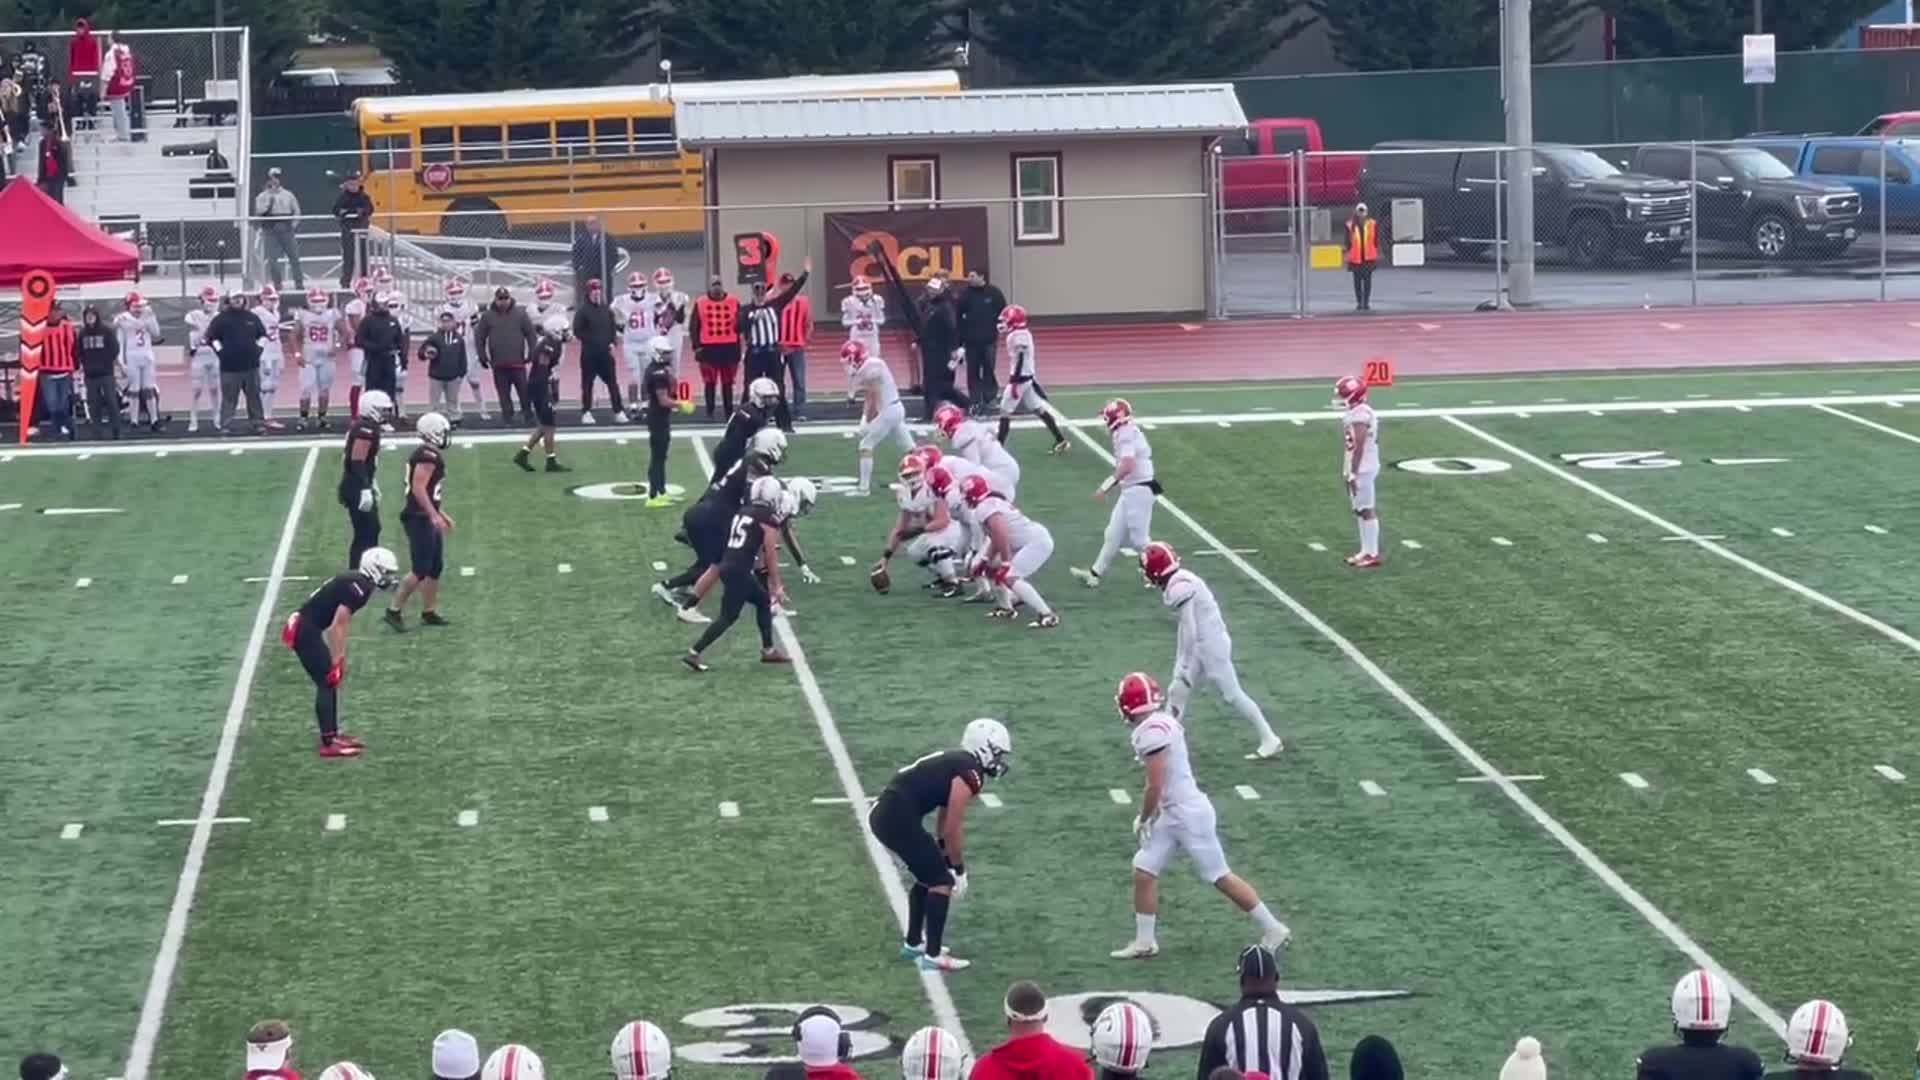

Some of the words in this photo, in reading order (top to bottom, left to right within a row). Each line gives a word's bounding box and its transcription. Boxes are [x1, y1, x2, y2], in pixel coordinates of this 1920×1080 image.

[738, 239, 761, 265] 3
[629, 311, 645, 329] 61
[310, 326, 328, 341] 62
[1367, 362, 1388, 381] 20
[728, 515, 754, 549] 15
